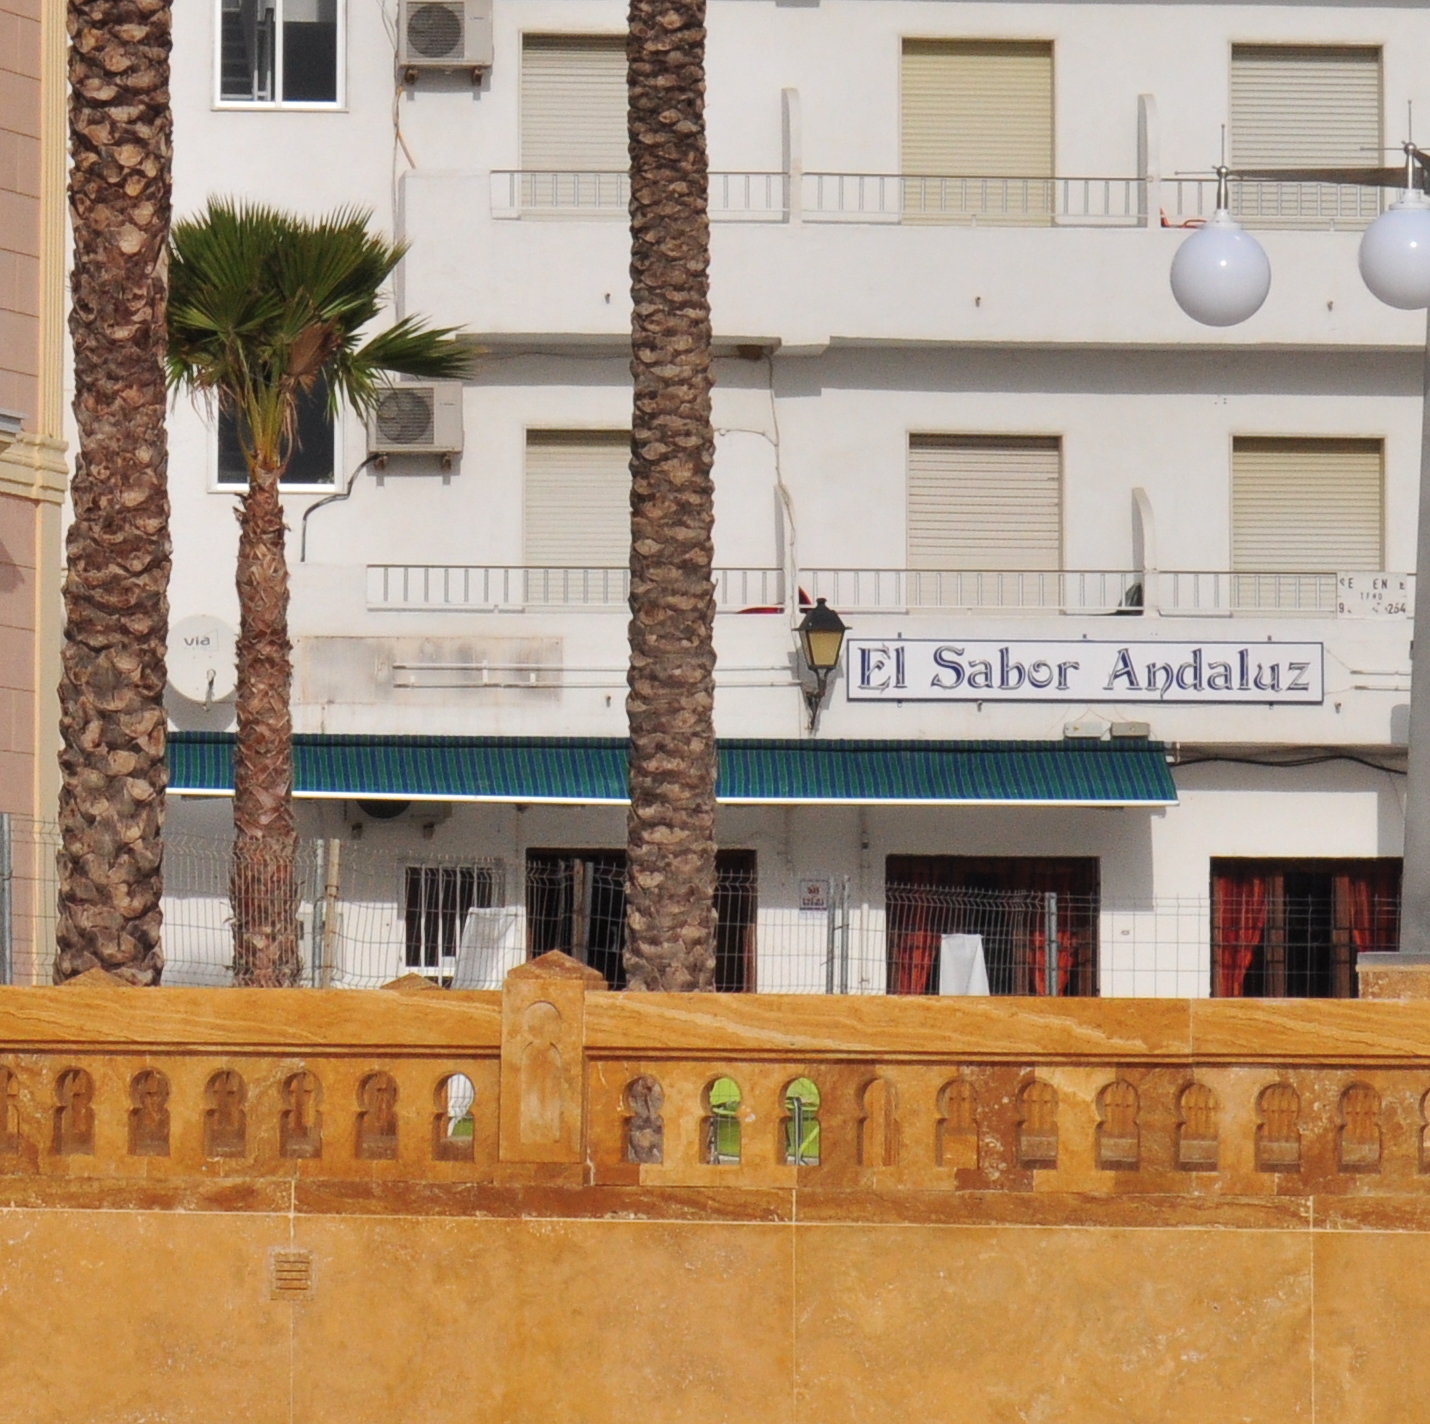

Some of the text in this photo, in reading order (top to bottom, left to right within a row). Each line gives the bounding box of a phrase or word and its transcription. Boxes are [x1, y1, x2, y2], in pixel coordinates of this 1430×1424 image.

[183, 636, 211, 646] via
[857, 643, 1311, 699] El Sabor Andaluz
